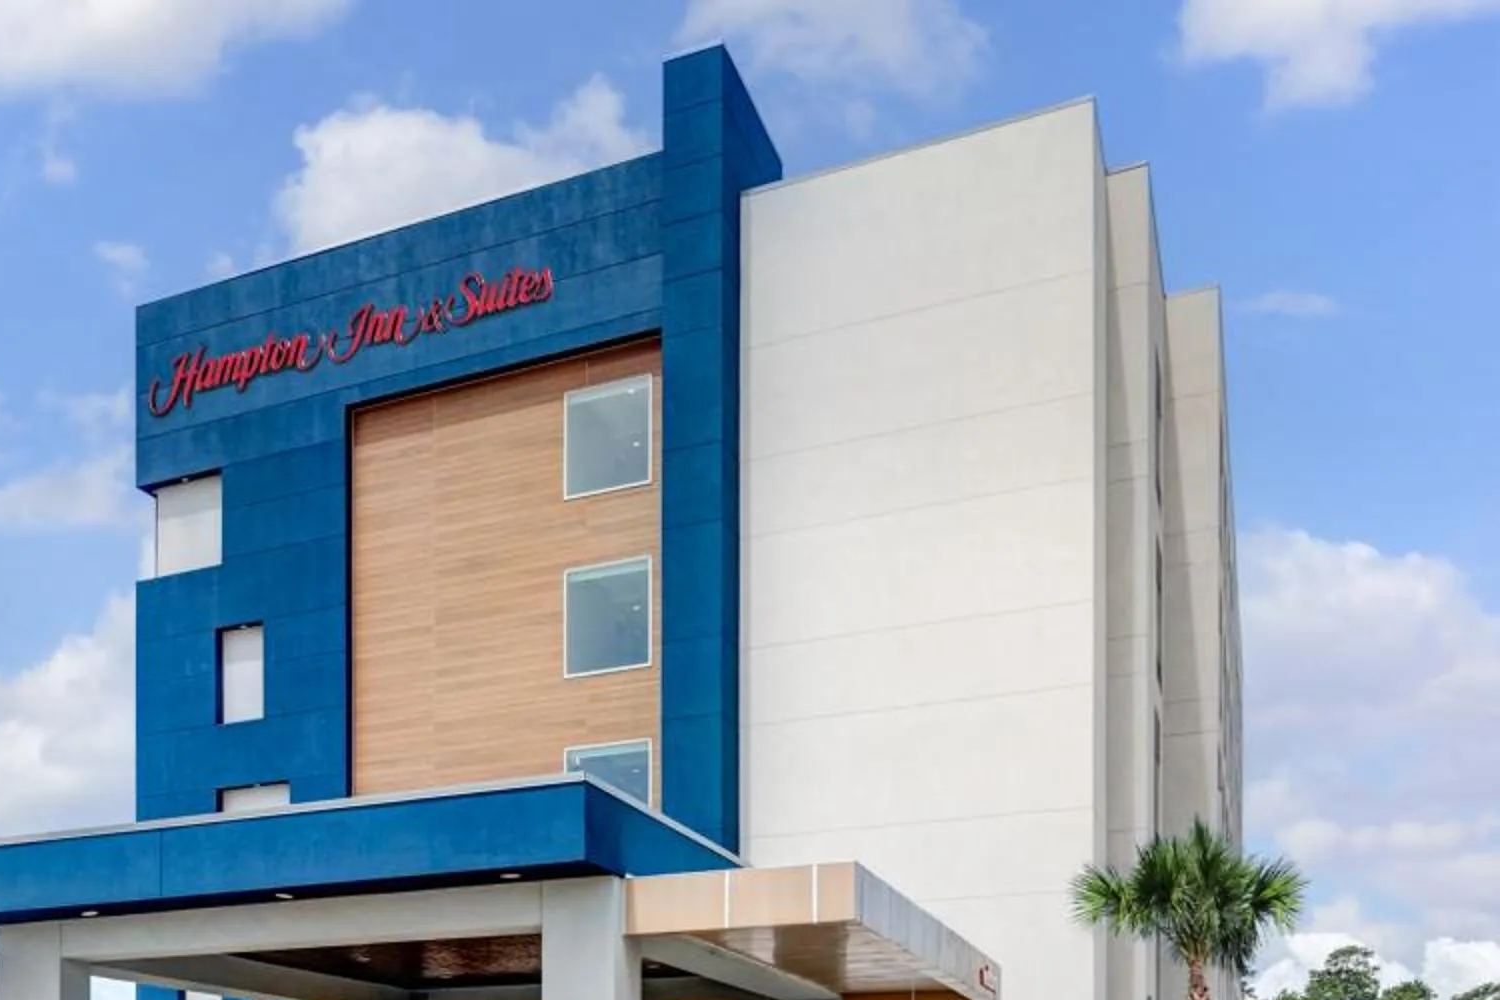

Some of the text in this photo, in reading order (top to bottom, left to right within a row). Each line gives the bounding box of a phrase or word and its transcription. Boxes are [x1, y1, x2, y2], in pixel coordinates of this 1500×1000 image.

[149, 266, 554, 417] Hampton Inn & Suites
